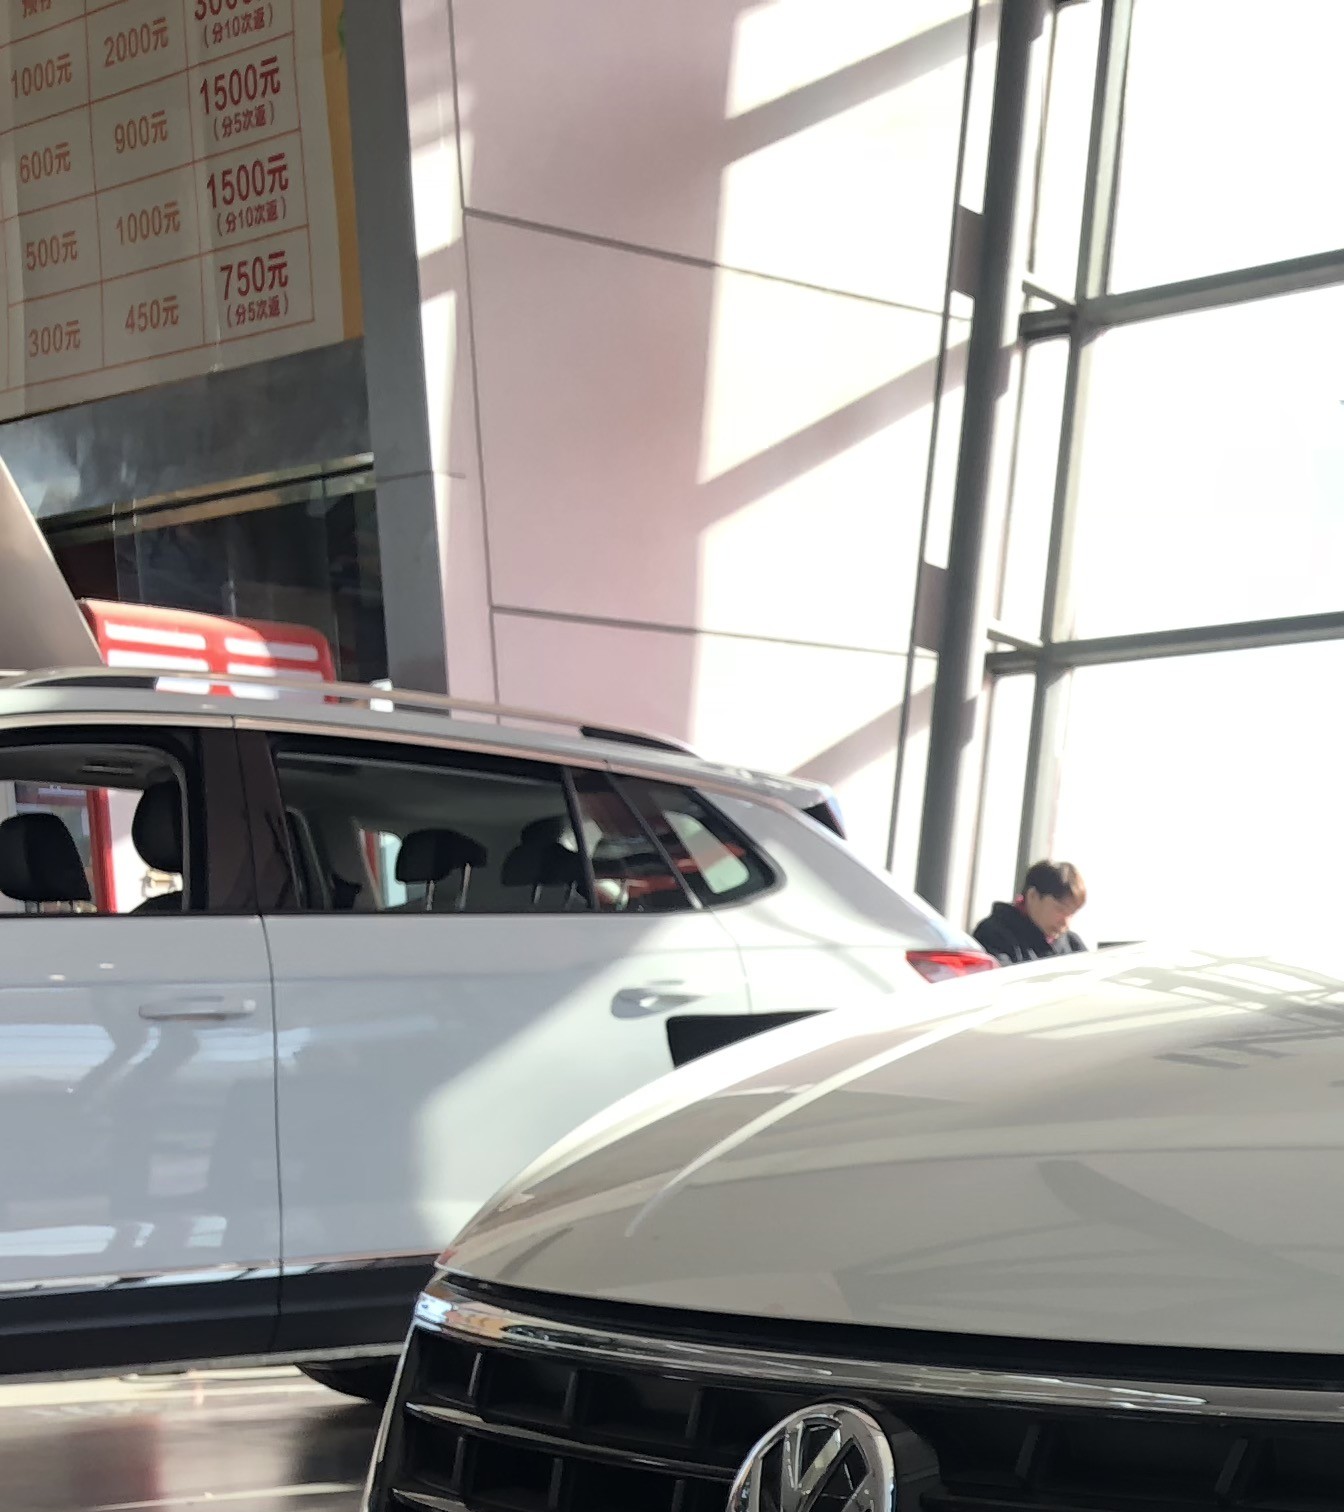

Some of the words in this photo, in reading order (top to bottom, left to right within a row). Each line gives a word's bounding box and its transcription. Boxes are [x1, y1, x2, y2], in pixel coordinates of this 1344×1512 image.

[104, 17, 168, 67] 2000元
[11, 53, 72, 98] 1000元
[200, 56, 280, 114] 1500元
[115, 110, 168, 153] 900元
[20, 142, 71, 182] 600元
[207, 153, 288, 208] 1500元
[116, 202, 180, 246] 1000元
[26, 230, 78, 271] 500元
[220, 250, 288, 301] 750元
[125, 295, 179, 336] 450元
[28, 320, 81, 357] 300元
